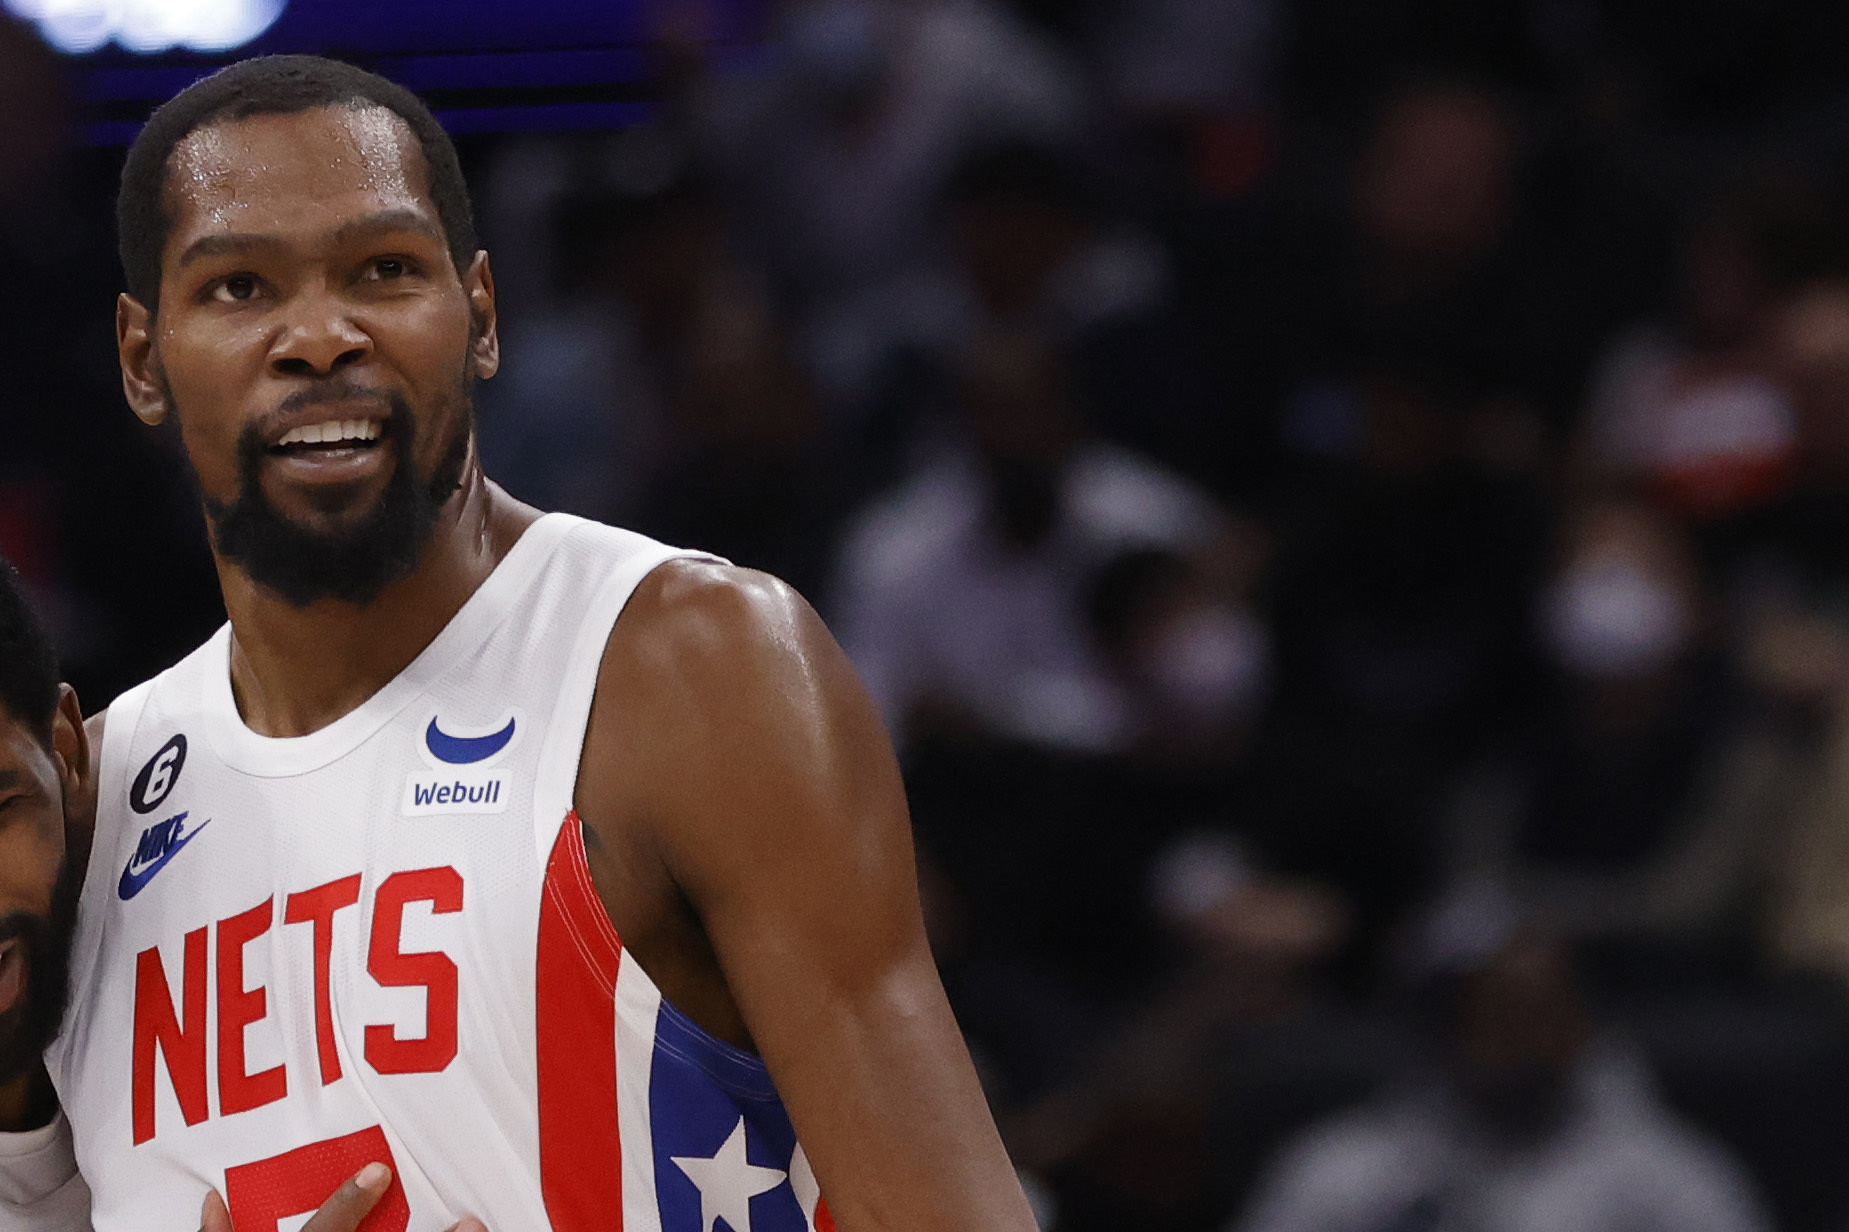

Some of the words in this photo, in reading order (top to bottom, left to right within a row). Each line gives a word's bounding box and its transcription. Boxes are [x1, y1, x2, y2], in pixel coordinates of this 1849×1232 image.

[143, 745, 180, 805] 6
[414, 780, 501, 806] Webull
[131, 811, 189, 869] NIKE
[132, 865, 464, 1147] NETS
